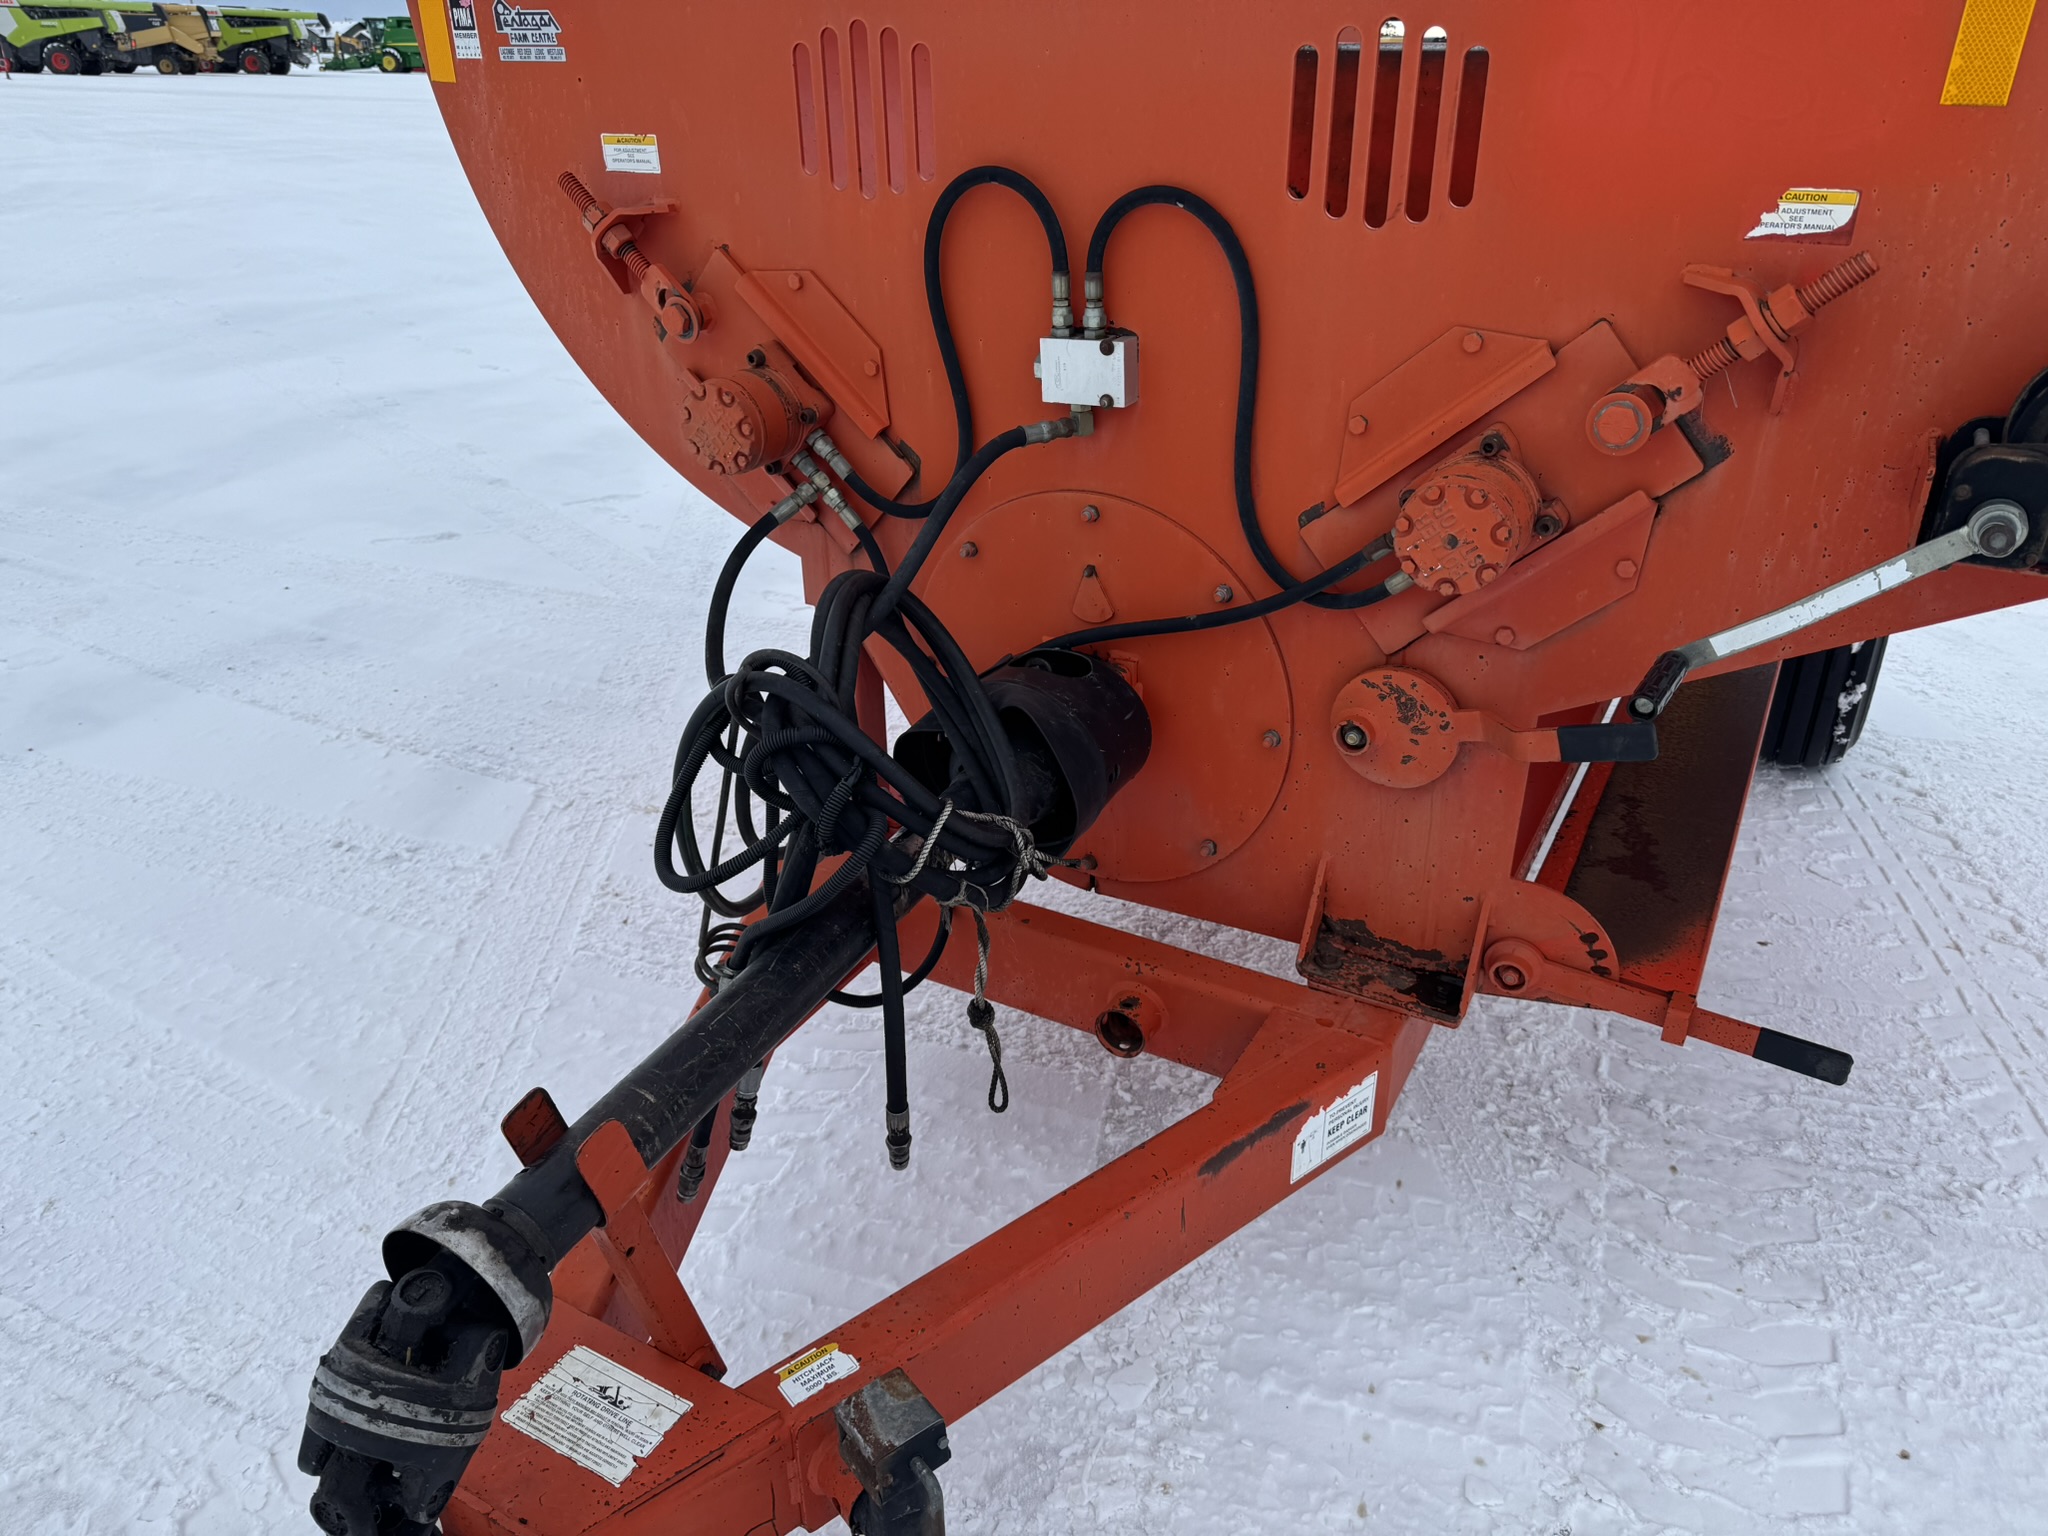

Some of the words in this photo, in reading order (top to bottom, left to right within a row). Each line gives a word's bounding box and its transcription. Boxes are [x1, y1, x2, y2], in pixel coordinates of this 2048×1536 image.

[510, 33, 530, 43] FARM
[531, 33, 556, 43] CENTRE
[1785, 193, 1828, 202] CAUTION
[1781, 208, 1834, 216] ADJUSTMENT
[1328, 1120, 1345, 1137] KEEP
[1346, 1105, 1368, 1125] CLEAR
[792, 1368, 815, 1384] HITCH
[816, 1356, 835, 1370] JACK
[794, 1347, 828, 1370] CAUTION
[800, 1364, 835, 1387] MAXIMUM
[805, 1380, 822, 1393] 5000
[571, 1389, 602, 1408] ROTATING
[599, 1405, 620, 1419] DRIVE
[617, 1415, 633, 1426] LINE
